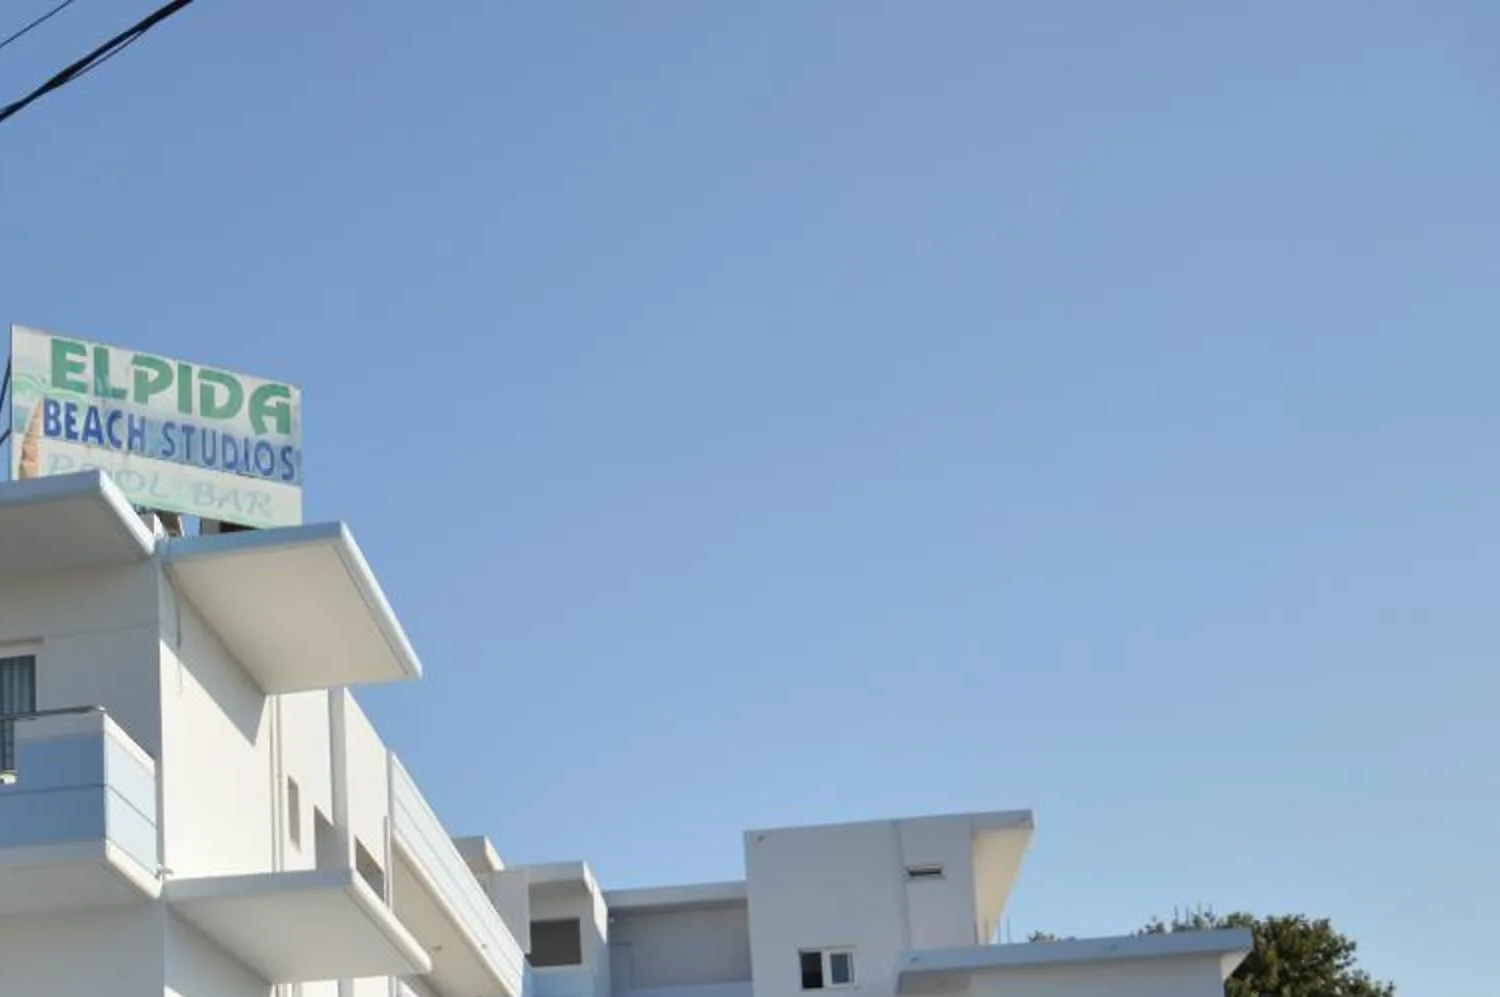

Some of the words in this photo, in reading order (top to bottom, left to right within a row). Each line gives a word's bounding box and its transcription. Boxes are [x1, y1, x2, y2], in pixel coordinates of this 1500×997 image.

[50, 337, 291, 434] ELPIDA
[43, 398, 145, 451] BEACH
[162, 421, 295, 480] STUDIOS
[48, 454, 171, 498] POL
[194, 482, 272, 517] BAR
